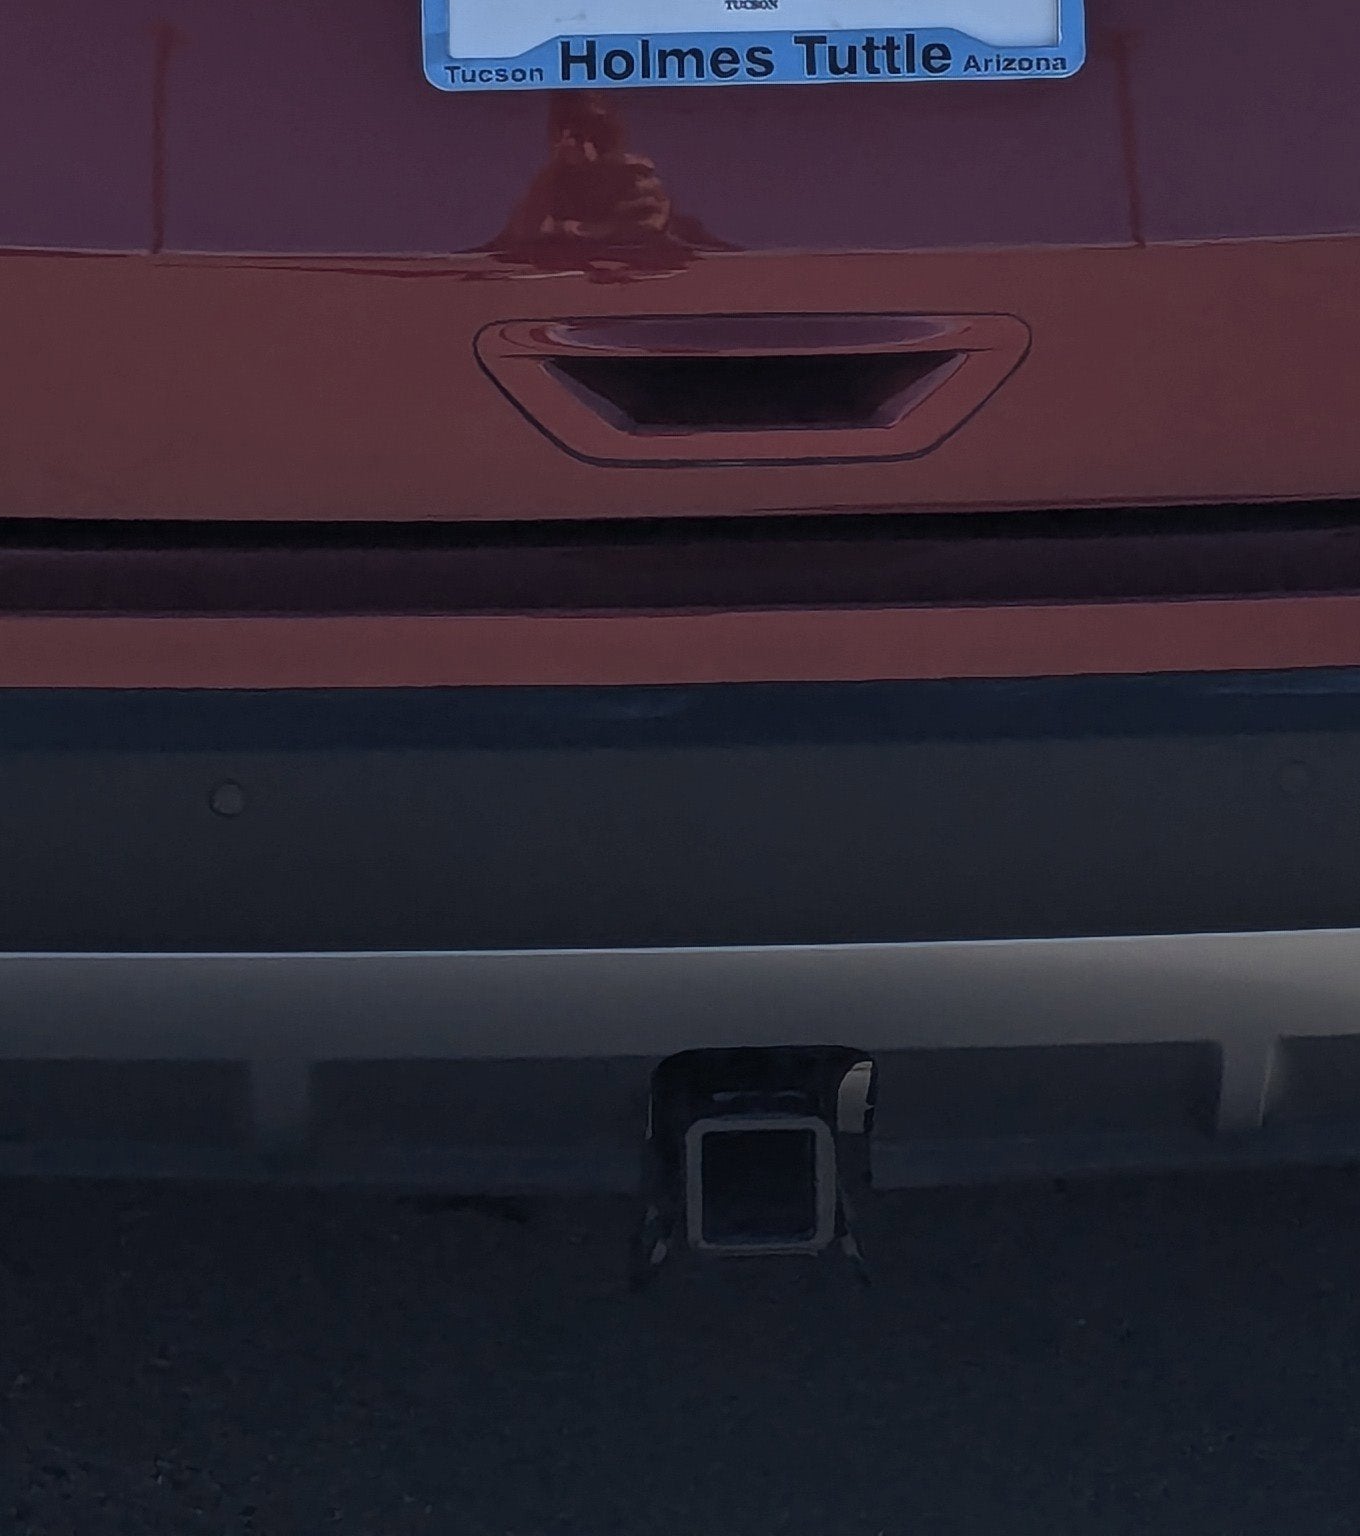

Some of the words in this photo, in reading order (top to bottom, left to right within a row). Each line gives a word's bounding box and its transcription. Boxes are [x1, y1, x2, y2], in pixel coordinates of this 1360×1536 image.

[724, 0, 779, 10] TUCSON
[444, 64, 544, 84] Tucson
[560, 39, 775, 82] Holmes
[794, 33, 952, 76] Tuttle
[963, 53, 1068, 73] Arizona
